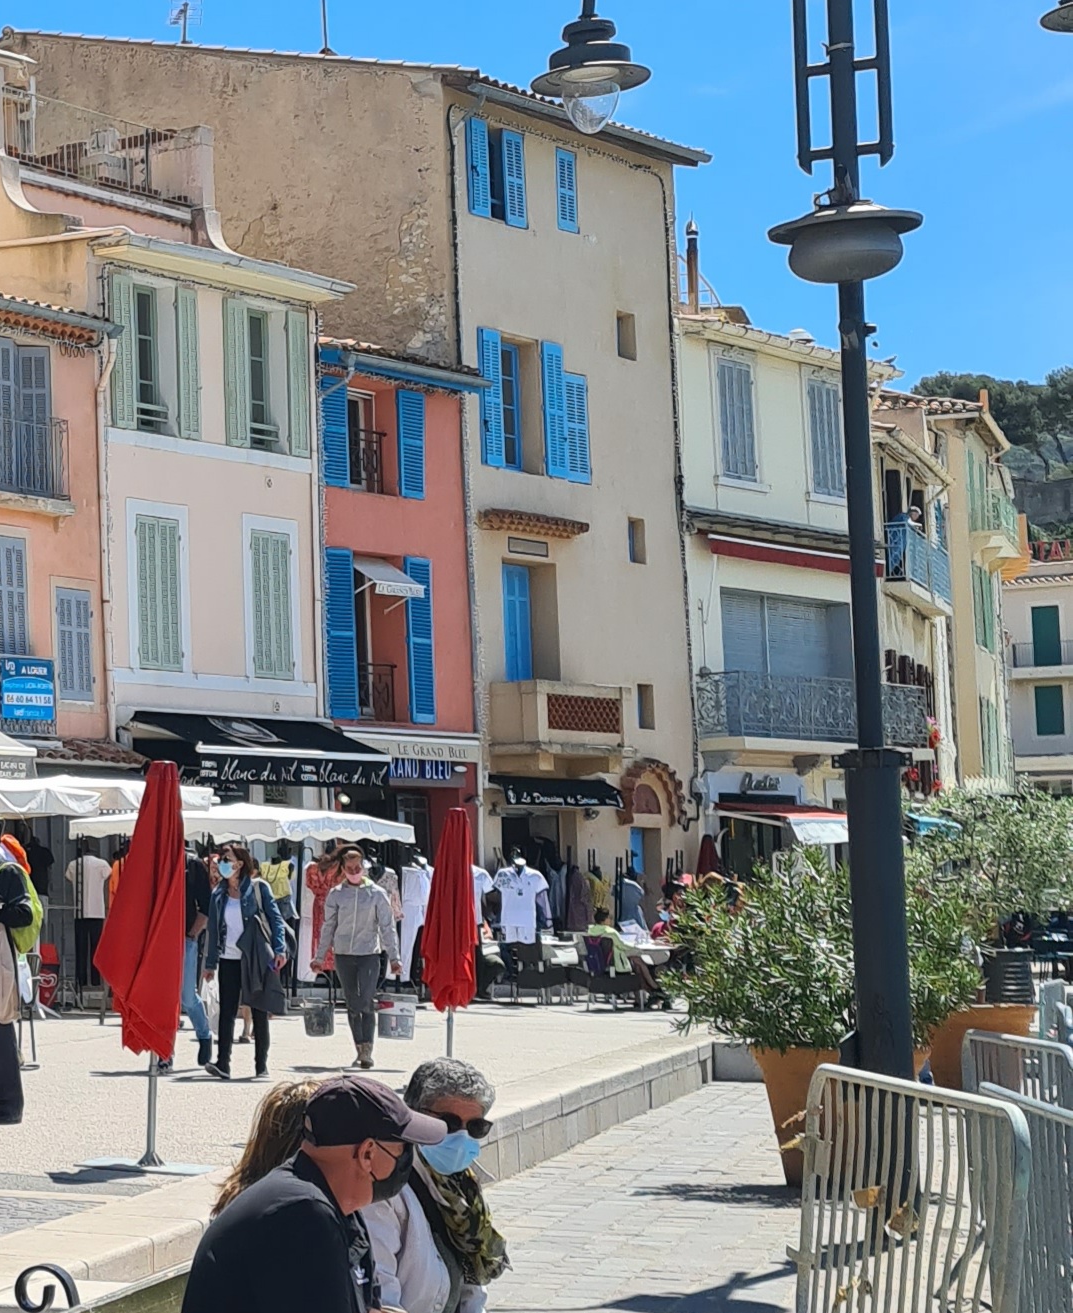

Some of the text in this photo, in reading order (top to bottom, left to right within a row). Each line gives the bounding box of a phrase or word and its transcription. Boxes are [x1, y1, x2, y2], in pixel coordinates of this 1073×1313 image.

[220, 757, 258, 781] blanc
[260, 762, 276, 782] du
[318, 760, 350, 784] blanc
[352, 766, 366, 786] du
[390, 758, 419, 778] RAND
